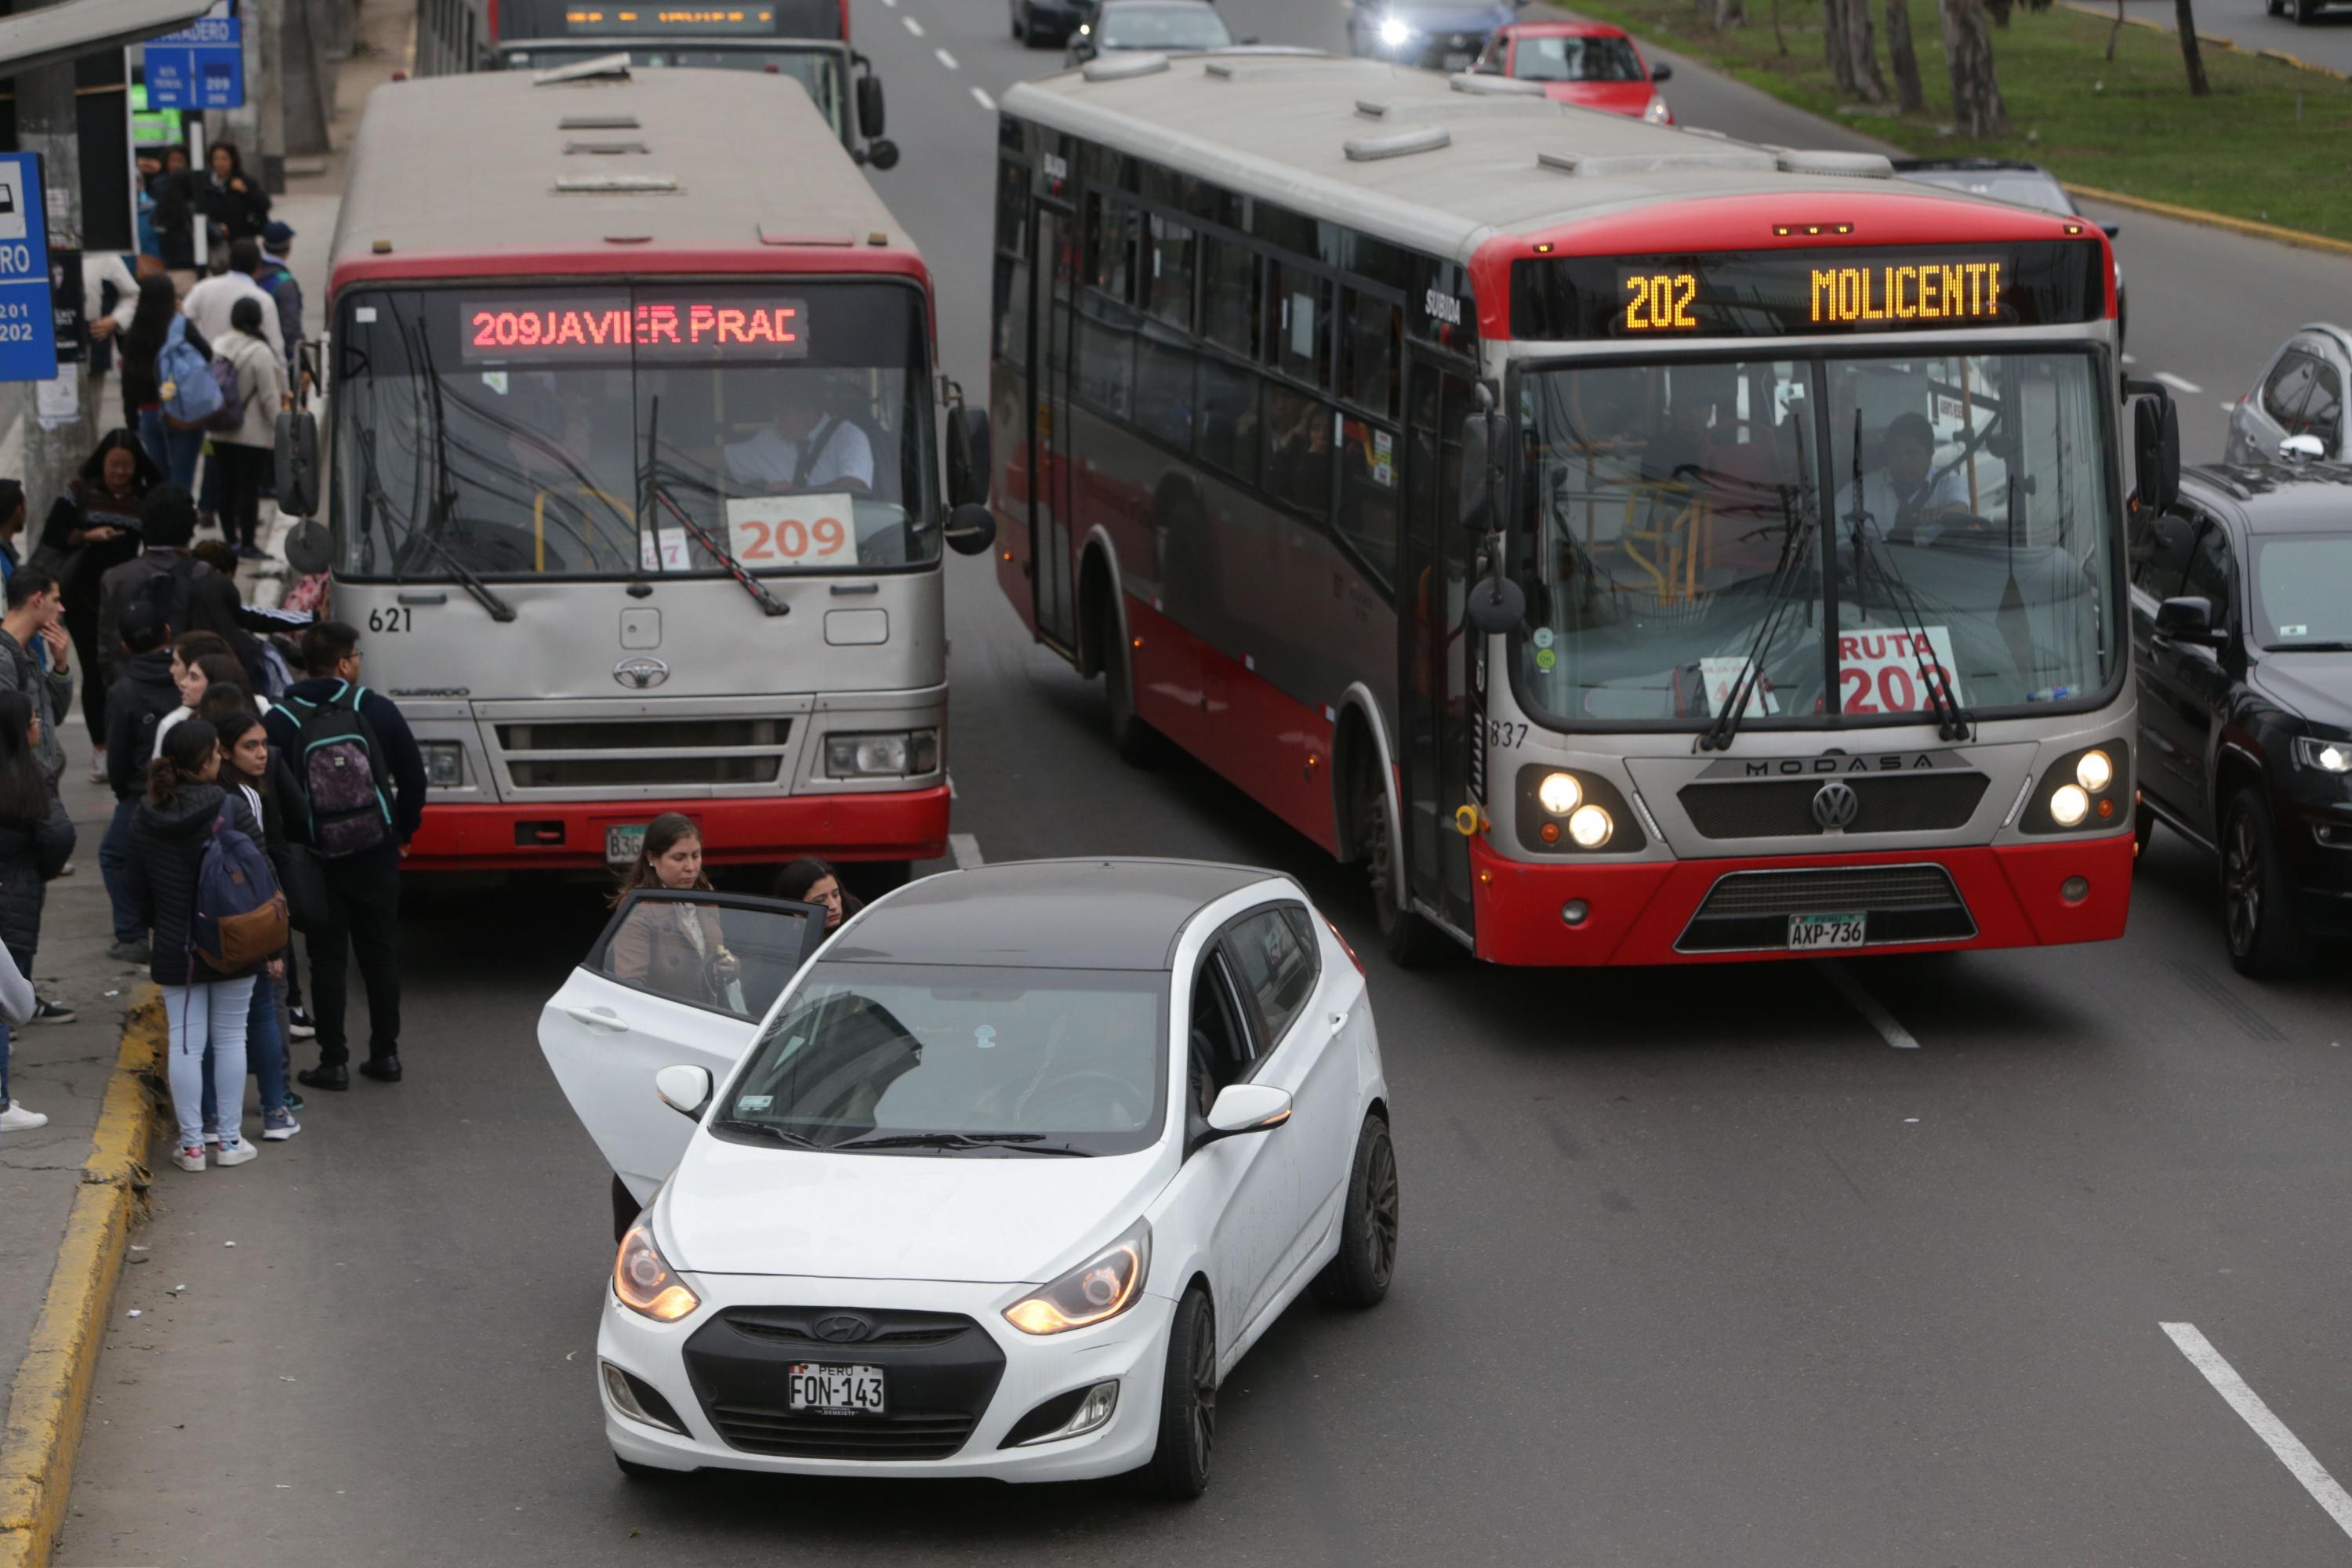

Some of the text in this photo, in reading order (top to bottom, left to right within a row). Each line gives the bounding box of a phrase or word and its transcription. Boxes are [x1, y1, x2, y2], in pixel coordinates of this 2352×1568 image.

[1425, 289, 1461, 325] SUBIDA
[1627, 274, 1696, 328] 202
[0, 323, 33, 342] 202
[739, 517, 846, 559] 209
[368, 608, 411, 633] 621
[1838, 633, 1936, 661] RUTA
[1839, 664, 1952, 715] 202
[1490, 720, 1529, 749] 837
[1746, 754, 1933, 776] MODASA
[1792, 922, 1861, 945] AXP-736
[819, 1367, 853, 1376] PERU
[790, 1375, 882, 1407] FON-143
